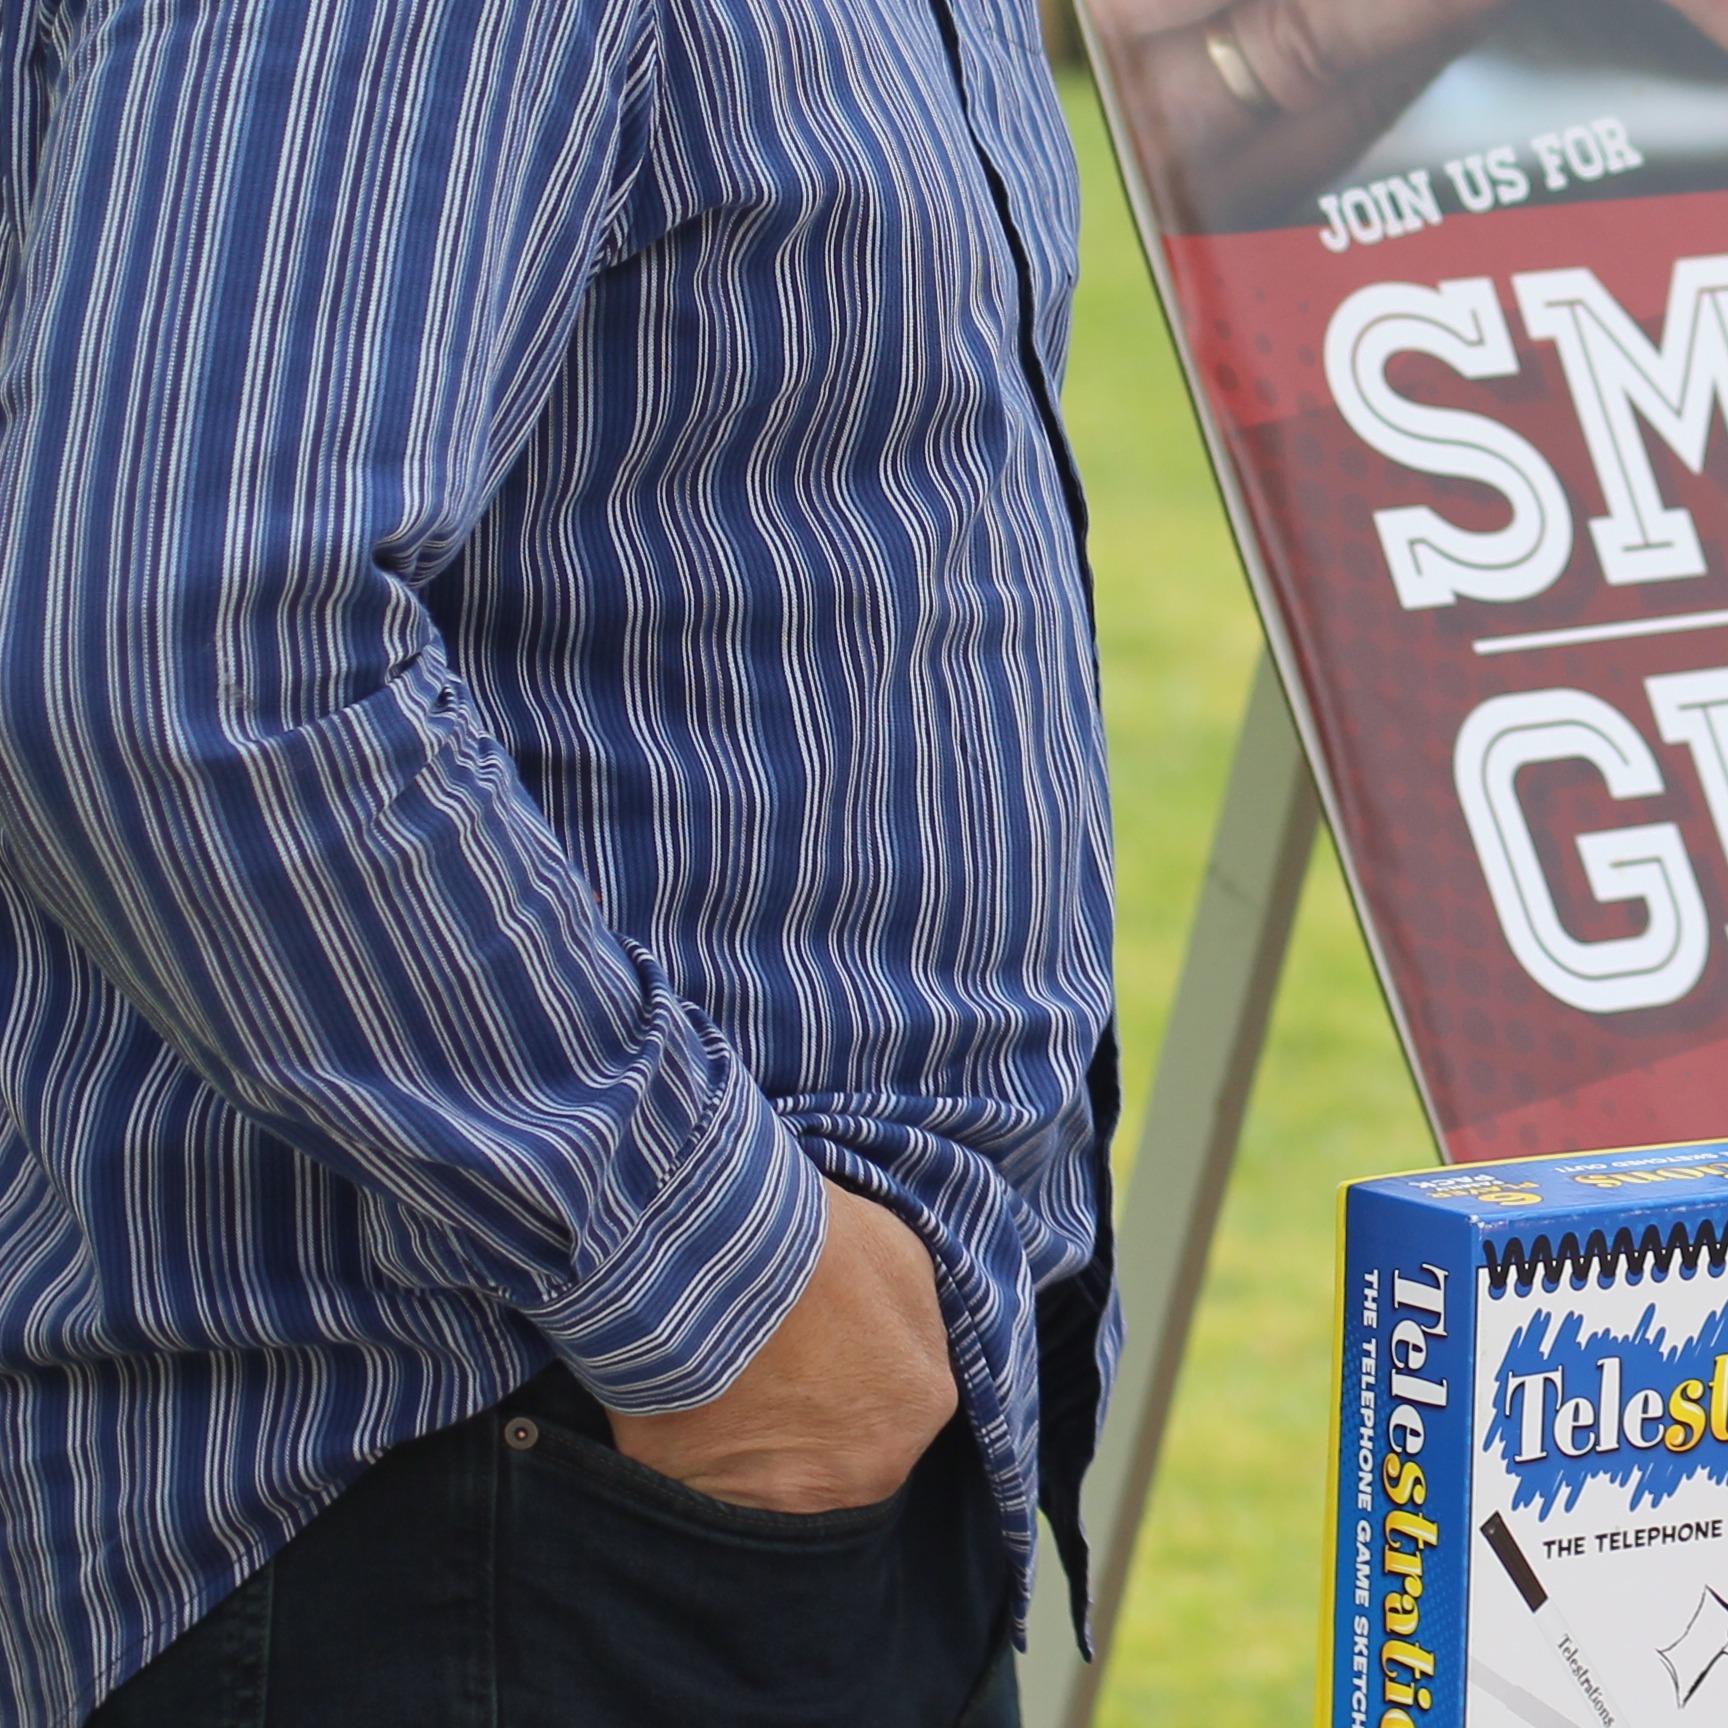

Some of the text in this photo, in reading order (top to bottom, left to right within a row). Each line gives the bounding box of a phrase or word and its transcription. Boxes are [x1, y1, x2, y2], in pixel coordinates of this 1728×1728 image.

[1317, 117, 1644, 253] JOIN US FOR
[1408, 1173, 1496, 1190] PACK
[1362, 1269, 1378, 1329] THE
[1357, 1338, 1377, 1511] TELEPHONE
[1354, 1519, 1372, 1608] GAME
[1543, 1536, 1586, 1560] THE
[1595, 1519, 1723, 1553] TELEPHONE
[1557, 1633, 1615, 1728] Telestrations
